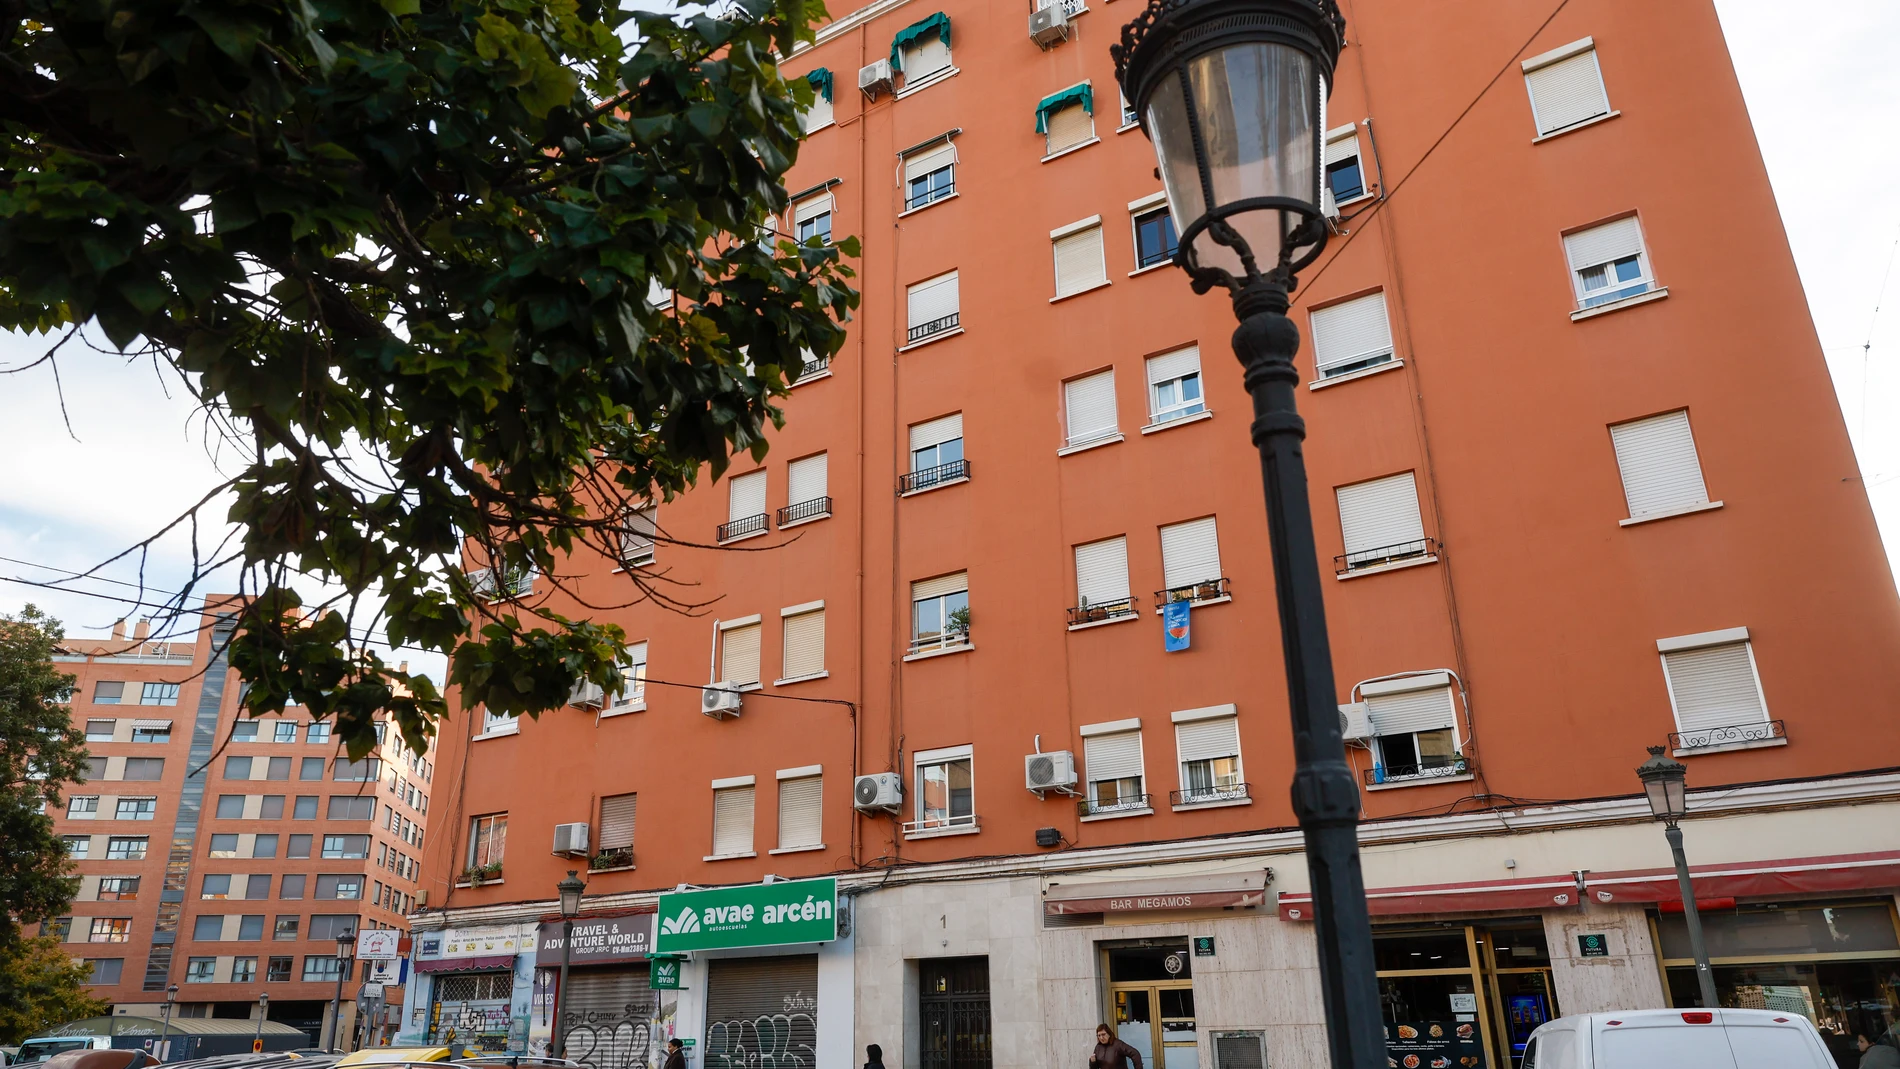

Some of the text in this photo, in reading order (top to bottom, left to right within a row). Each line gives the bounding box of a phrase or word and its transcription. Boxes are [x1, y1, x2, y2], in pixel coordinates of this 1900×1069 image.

[703, 895, 832, 925] avae arcén
[1110, 896, 1192, 910] BAR MEGAMOS
[708, 924, 748, 932] autoescuelas
[940, 914, 946, 928] 1
[570, 924, 618, 937] TRAVEL &
[544, 932, 644, 950] ADVNTURE WORLD
[534, 994, 554, 1004] VIAES
